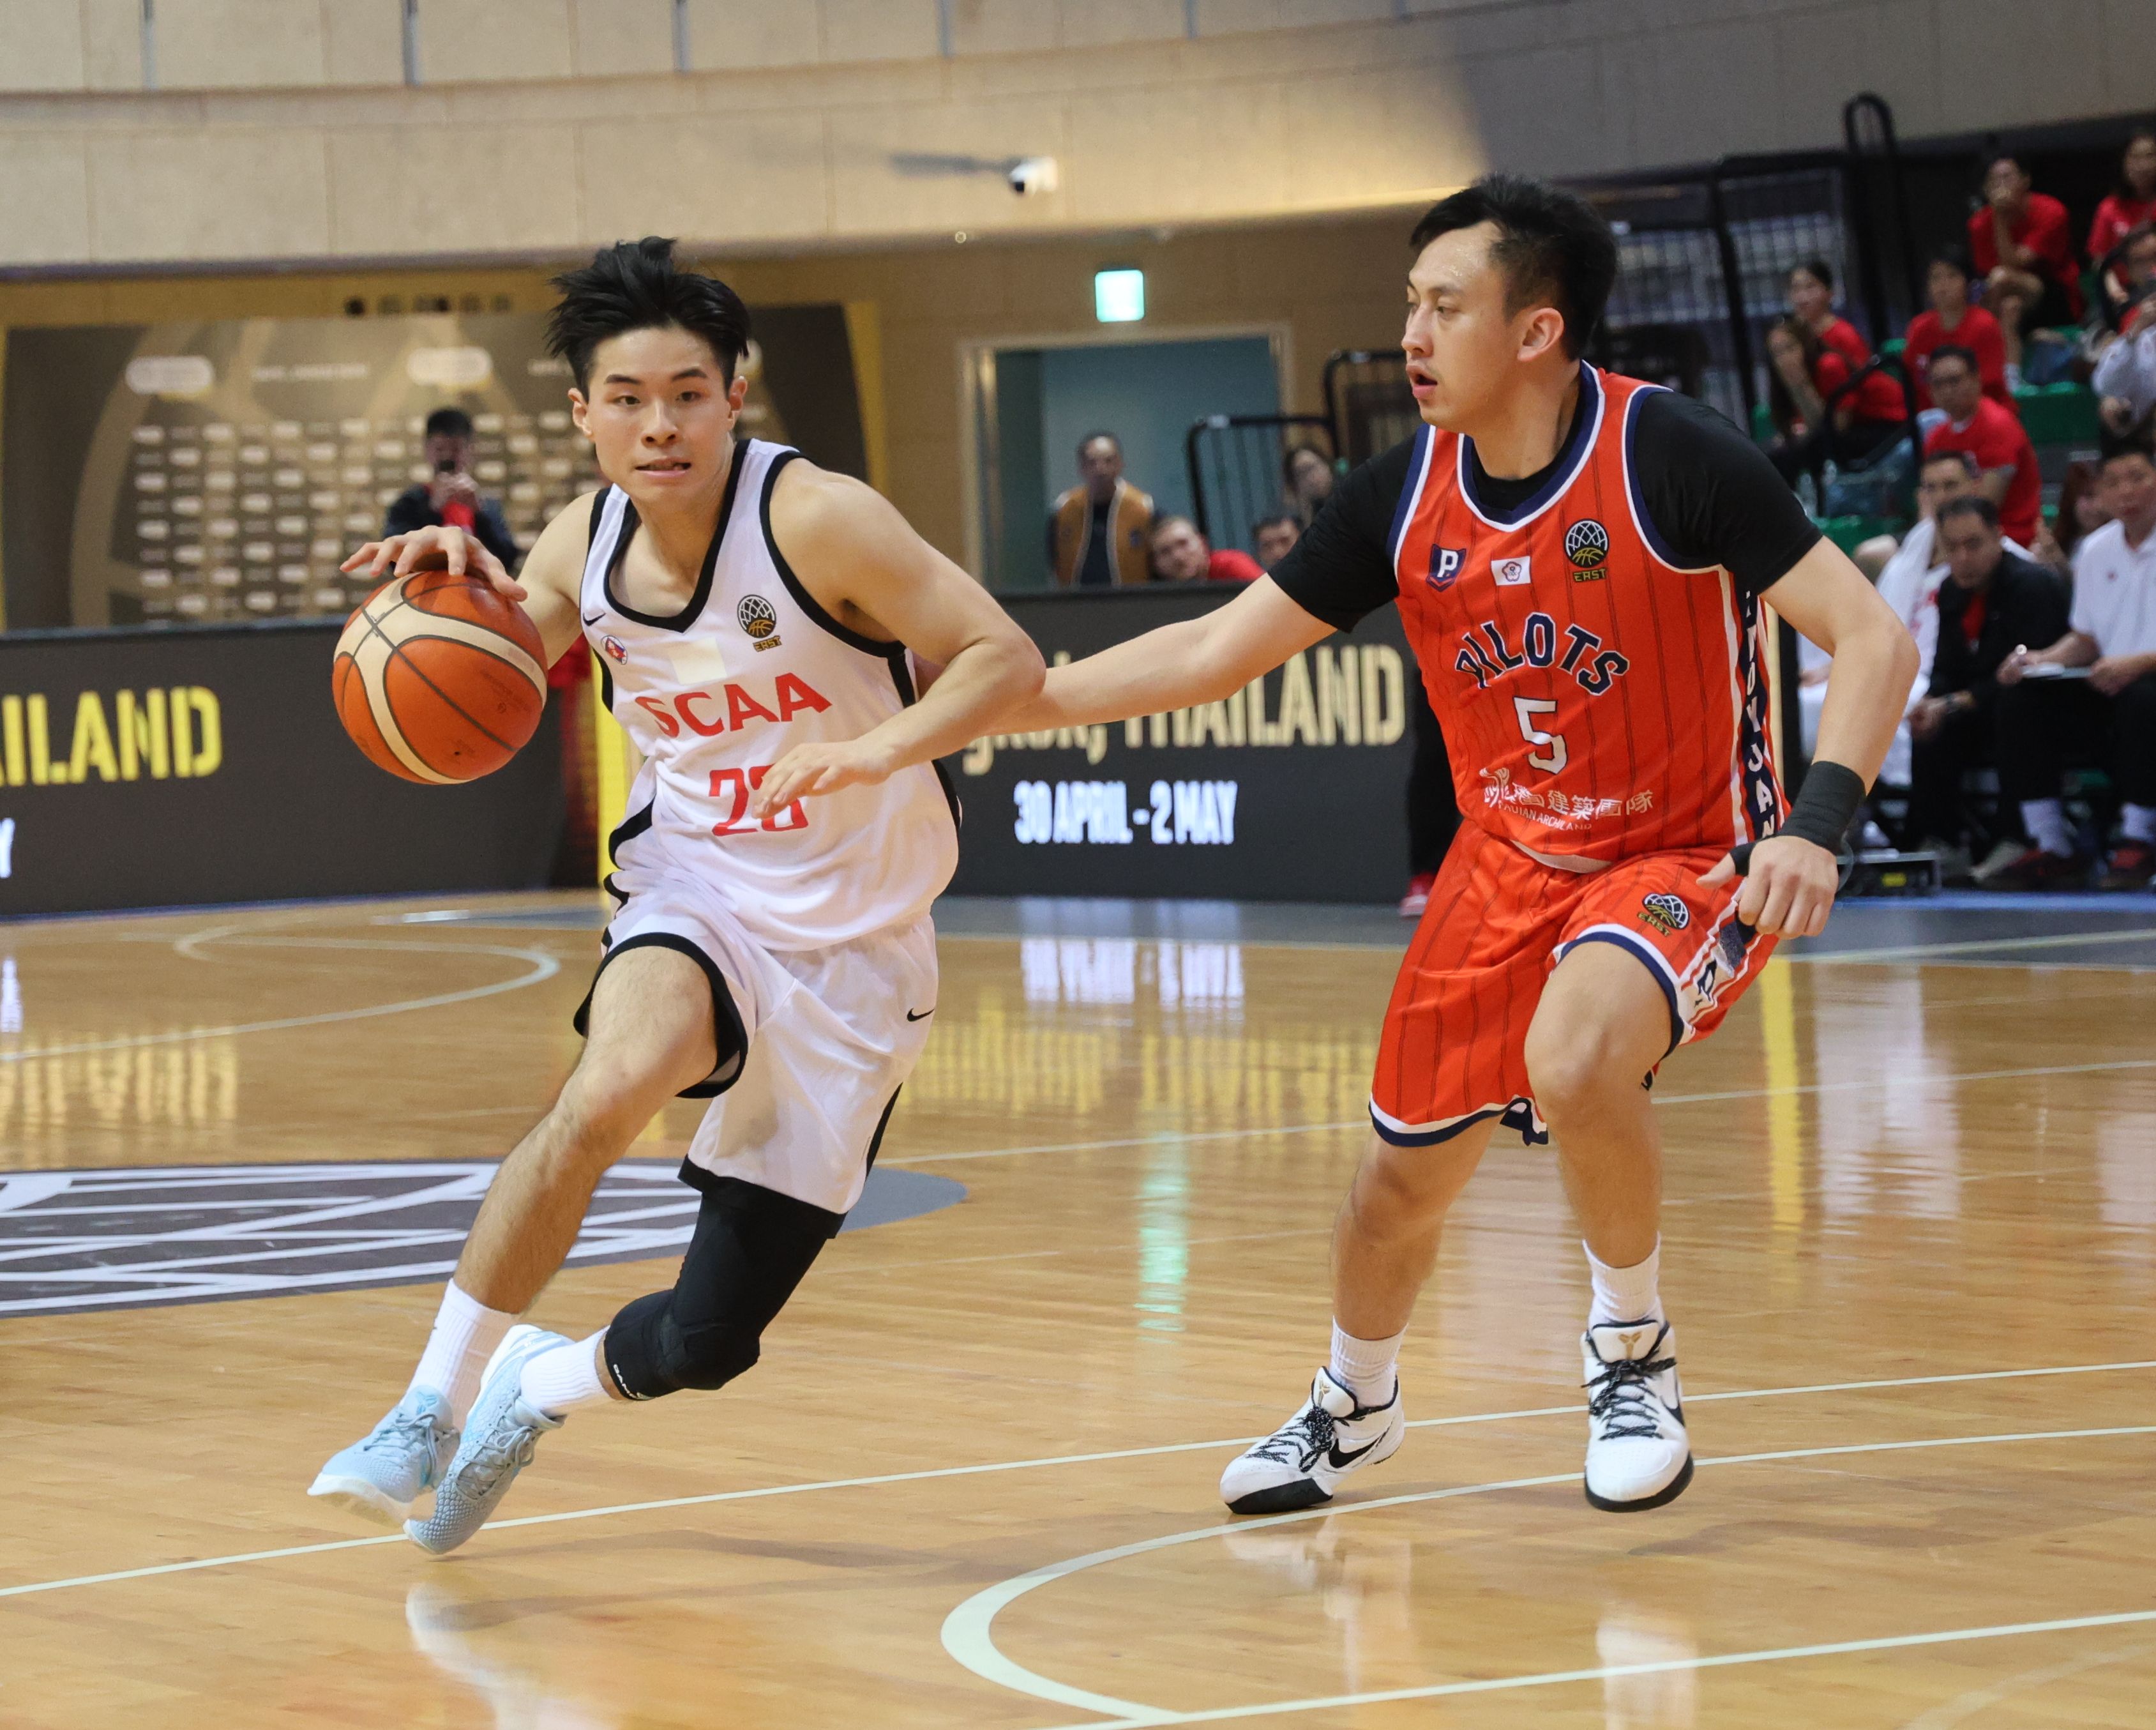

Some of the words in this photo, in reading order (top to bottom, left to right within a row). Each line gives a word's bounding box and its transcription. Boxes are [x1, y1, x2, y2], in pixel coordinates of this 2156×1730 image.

[1436, 549, 1459, 577] P
[1573, 568, 1606, 582] EAST
[753, 635, 782, 652] EAST
[1455, 611, 1630, 697] PILOTS
[635, 672, 833, 738] SCAA
[1124, 644, 1406, 747] ILAND
[0, 685, 222, 787] ILAND
[1512, 695, 1569, 775] 5
[1013, 780, 1053, 844] 30
[1053, 780, 1133, 844] APRIL
[1150, 779, 1173, 845] 2
[1173, 779, 1238, 845] MAY
